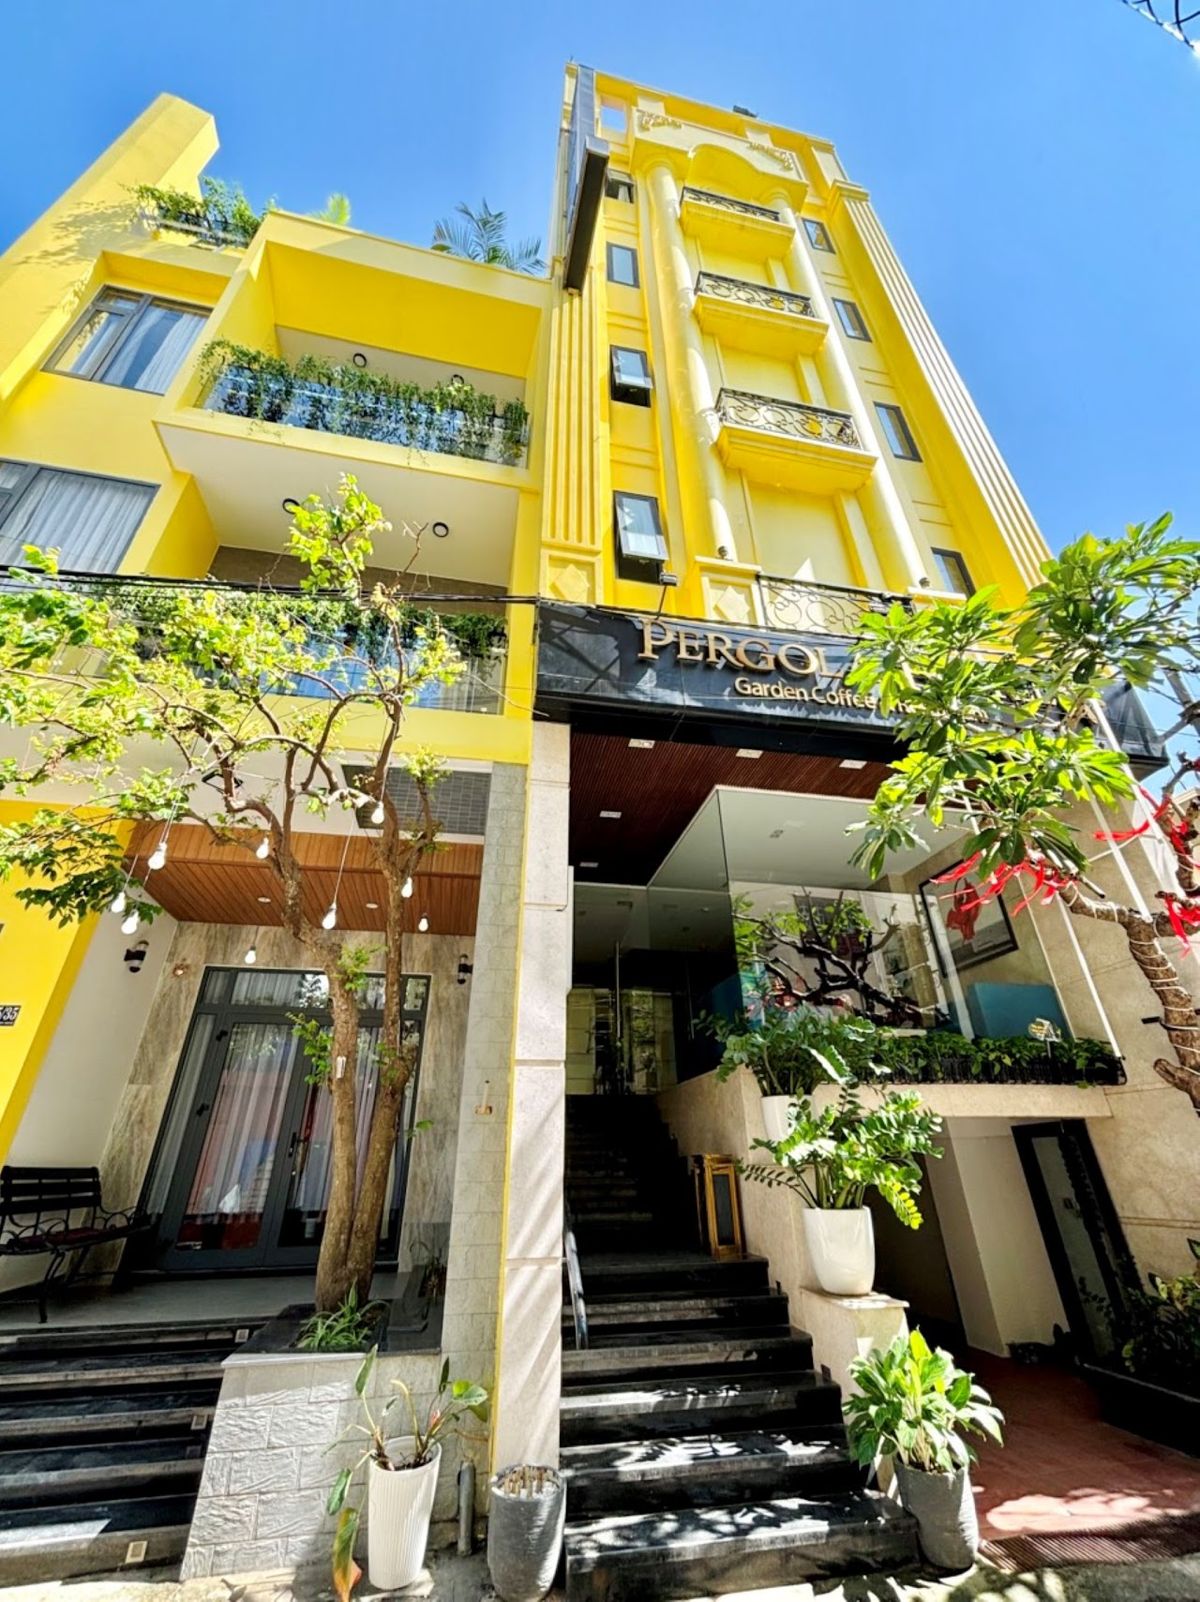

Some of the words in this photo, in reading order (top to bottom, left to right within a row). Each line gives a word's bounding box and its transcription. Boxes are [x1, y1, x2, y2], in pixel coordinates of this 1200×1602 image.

[638, 618, 858, 678] PERGOL
[734, 677, 809, 702] Garden
[812, 684, 877, 710] Coffee
